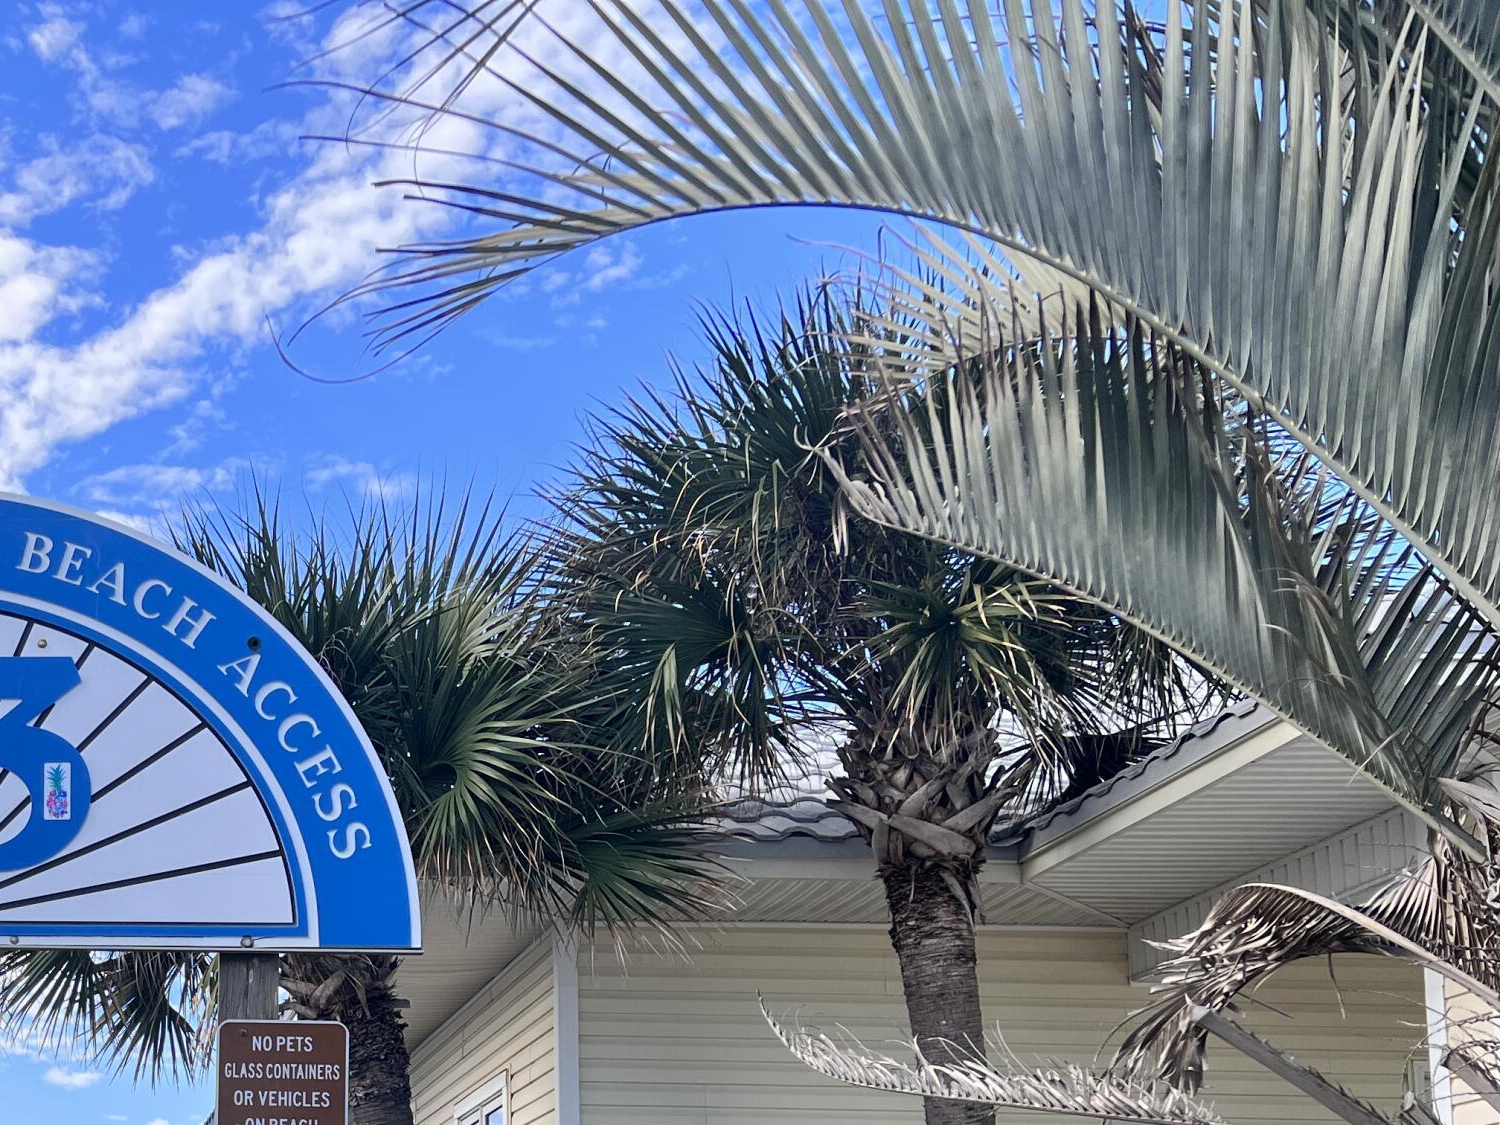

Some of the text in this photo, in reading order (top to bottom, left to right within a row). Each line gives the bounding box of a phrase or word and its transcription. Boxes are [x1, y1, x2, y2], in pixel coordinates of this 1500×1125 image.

[17, 531, 217, 650] BEACH
[217, 651, 373, 859] ACCESS
[252, 1036, 313, 1052] NO PETS
[224, 1062, 341, 1081] GLASS CONTAINERS
[233, 1090, 331, 1108] OR VEHICLES
